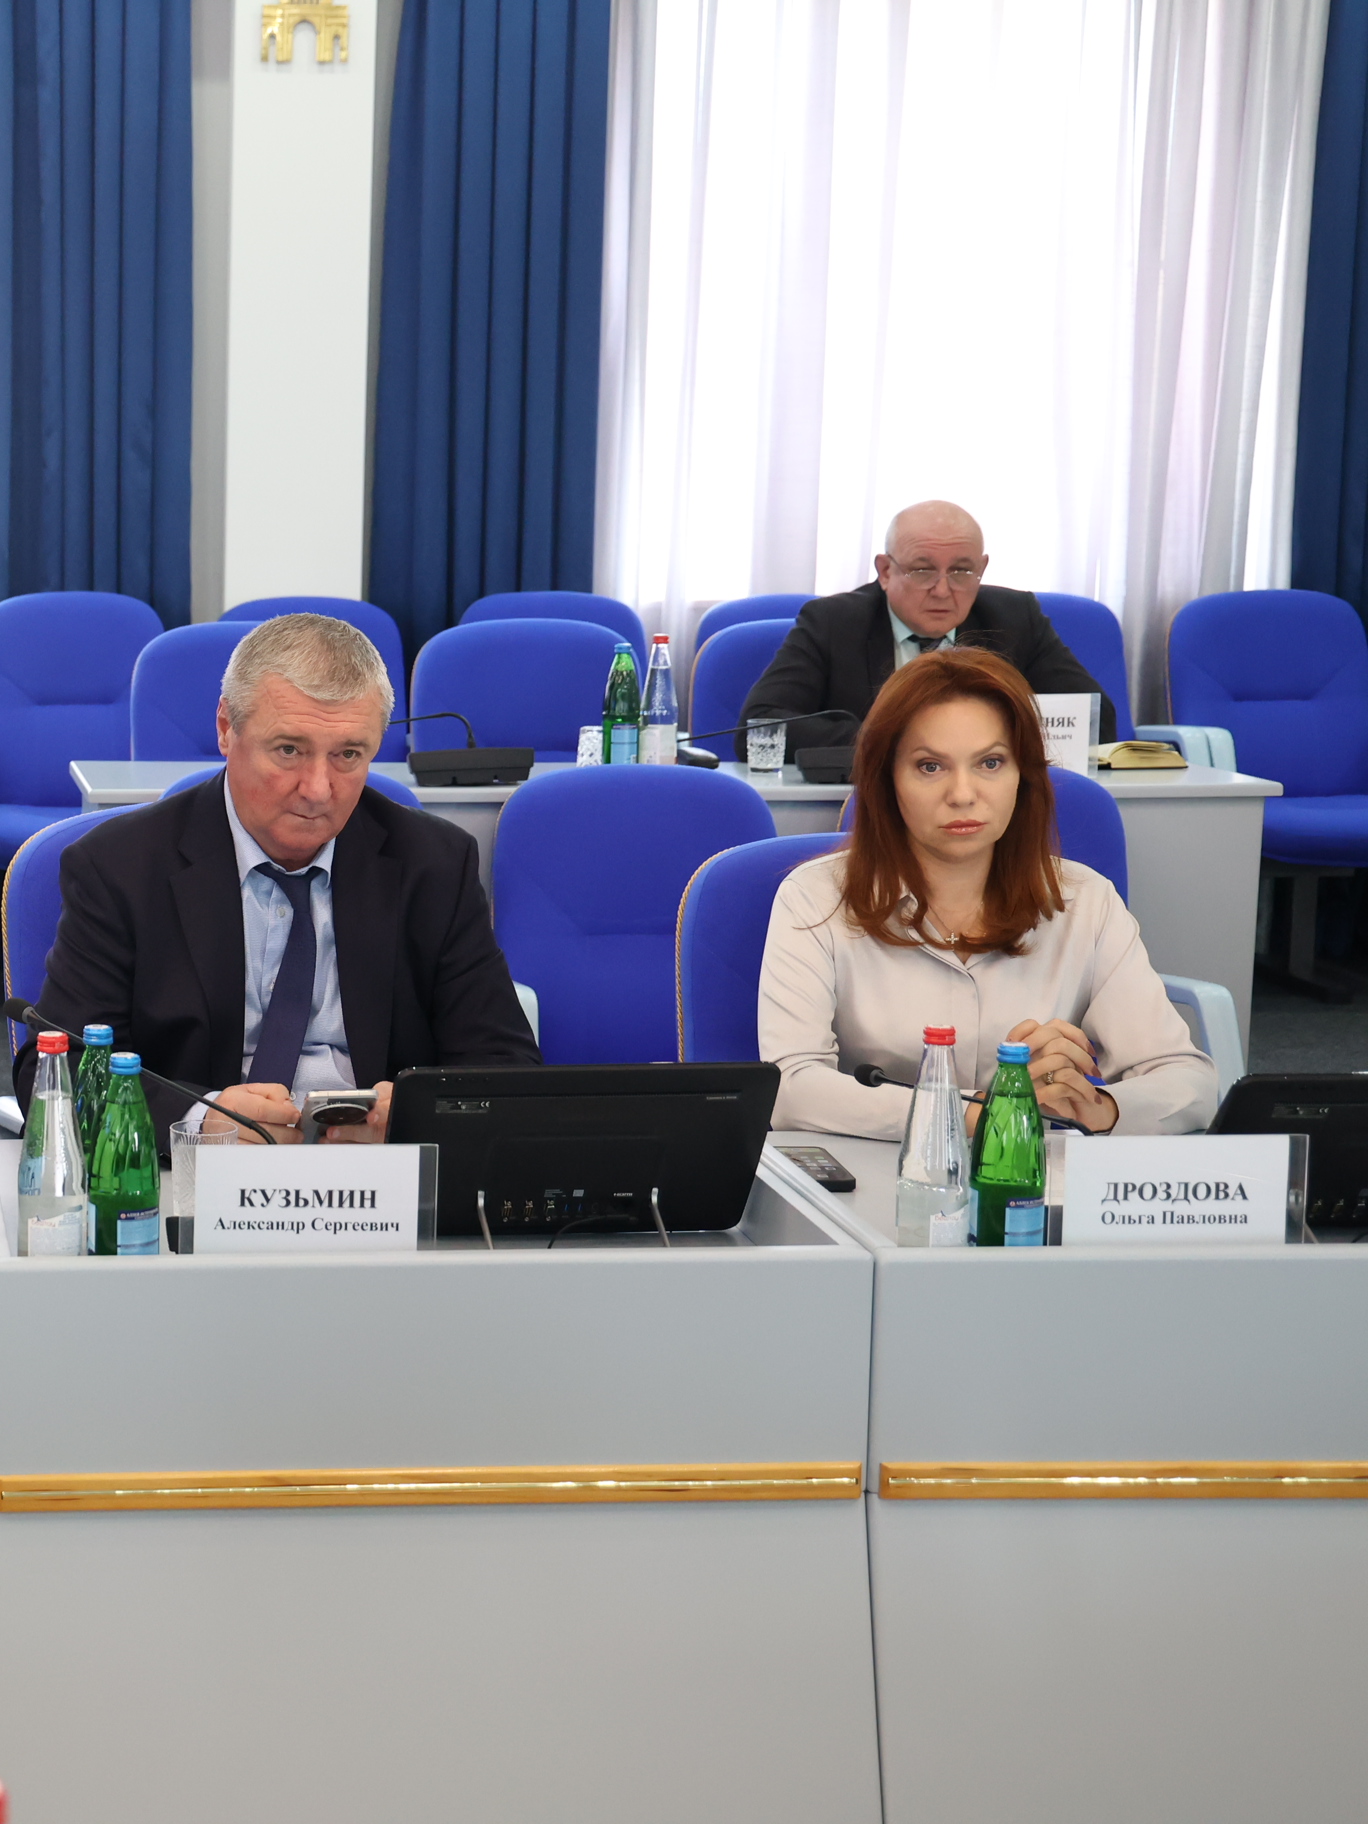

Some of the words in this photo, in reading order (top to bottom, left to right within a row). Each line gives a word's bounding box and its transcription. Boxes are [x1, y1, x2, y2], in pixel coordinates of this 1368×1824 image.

[1041, 716, 1077, 728] НЯК
[239, 1188, 378, 1210] КУЗЬМИН
[1101, 1181, 1249, 1205] ДРОЗДОВА
[213, 1216, 305, 1236] Александр
[310, 1216, 401, 1236] Сергеевич
[1100, 1210, 1155, 1226] Ольга
[1162, 1210, 1249, 1226] Павловна
